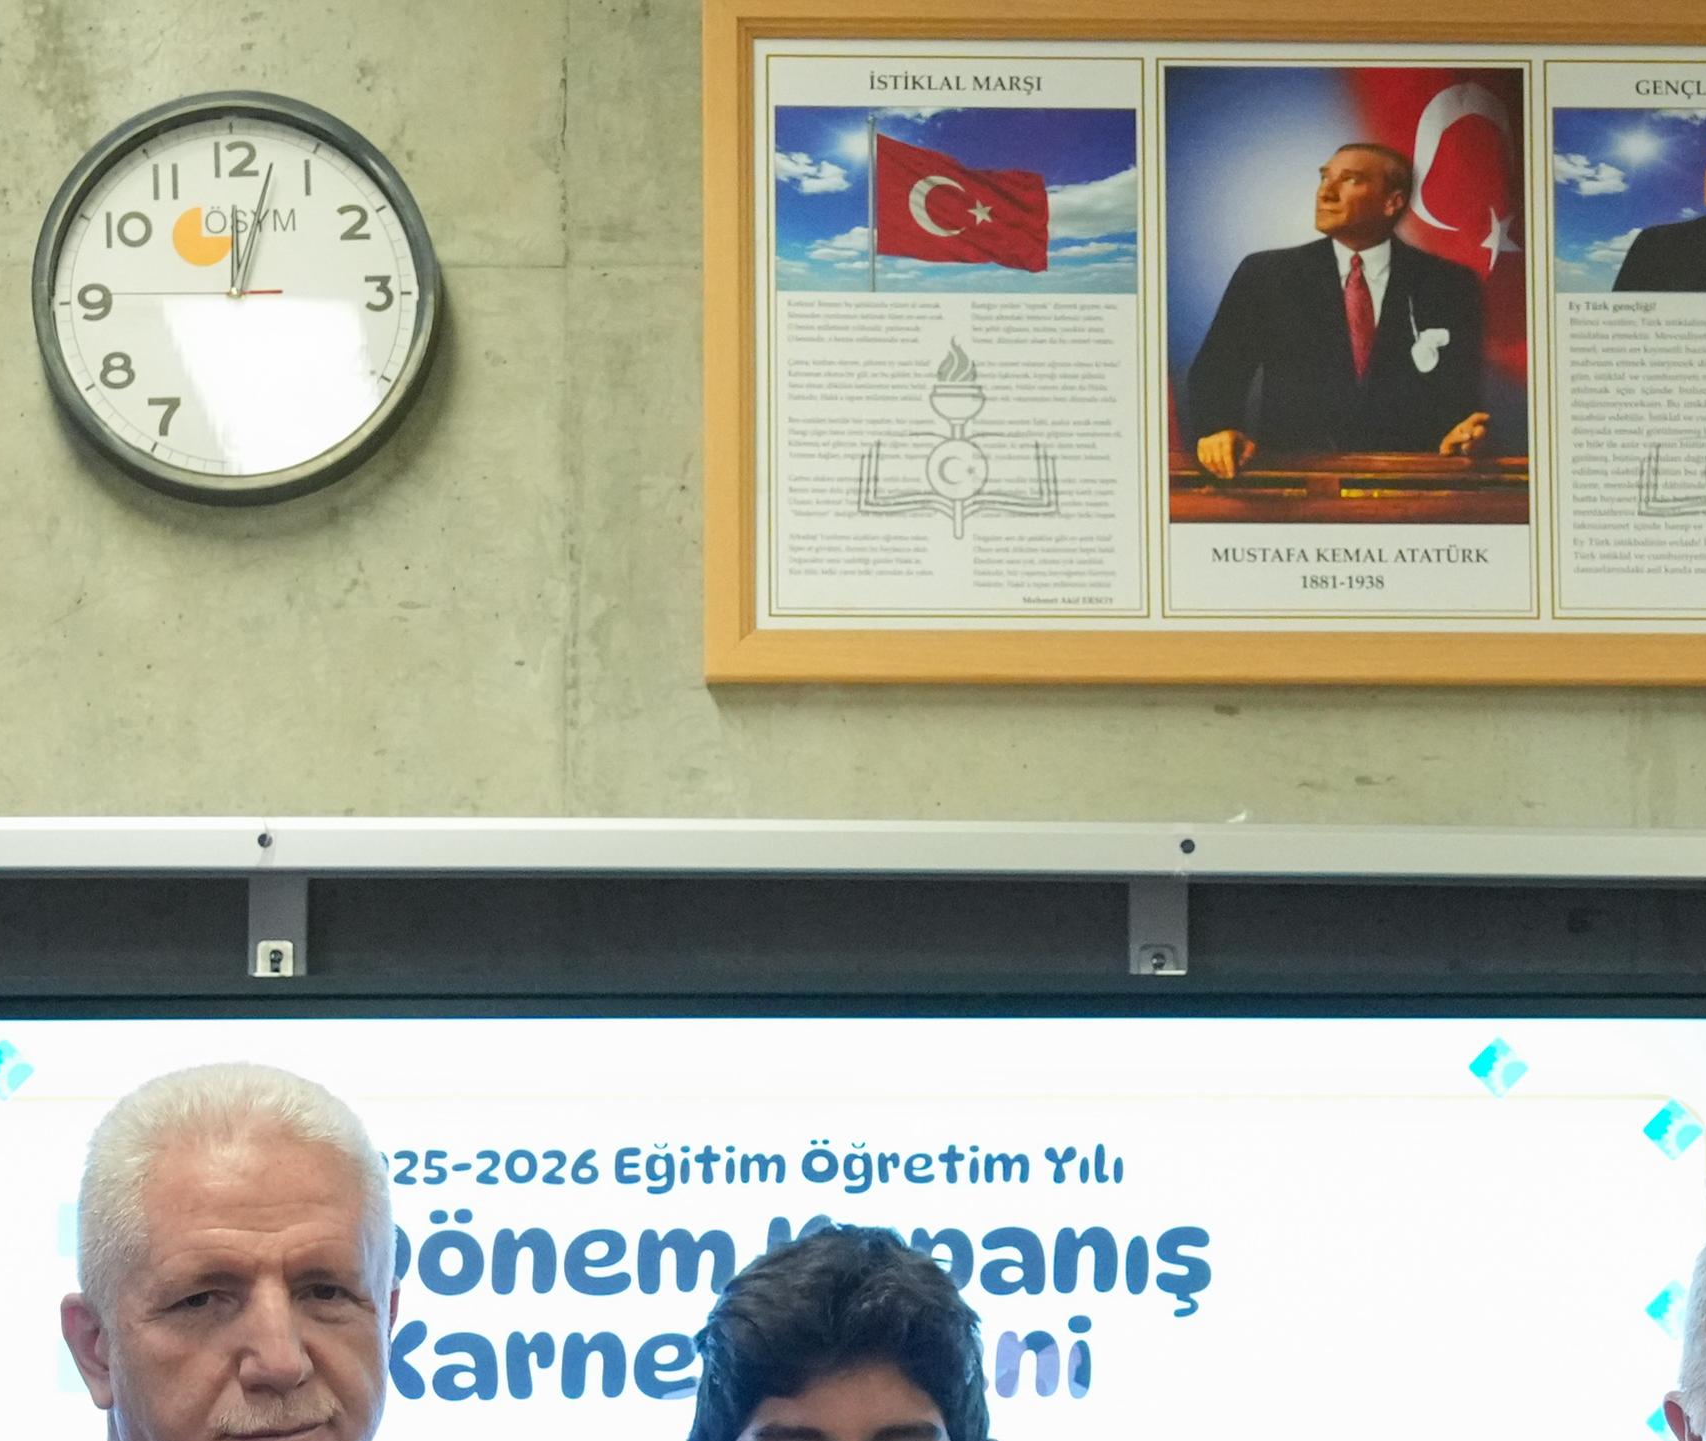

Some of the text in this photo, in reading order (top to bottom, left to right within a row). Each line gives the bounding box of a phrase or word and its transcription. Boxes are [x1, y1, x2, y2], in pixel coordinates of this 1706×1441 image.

[869, 70, 1043, 96] İSTİKLAL MARŞI
[214, 141, 259, 178] 12
[304, 159, 312, 196] 1
[153, 163, 178, 200] 11
[105, 211, 153, 249] 10
[204, 206, 297, 234] ÖSYM
[336, 204, 371, 241] 2
[77, 283, 114, 321] 9
[364, 275, 394, 312] 3
[99, 351, 136, 389] 8
[147, 396, 182, 437] 7
[1211, 543, 1489, 565] MUSTAFA KEMAL ATATÜRK
[1300, 574, 1385, 591] 1881-1938
[383, 1139, 1124, 1194] 25-2026 Eğitim Öğretim Yılı
